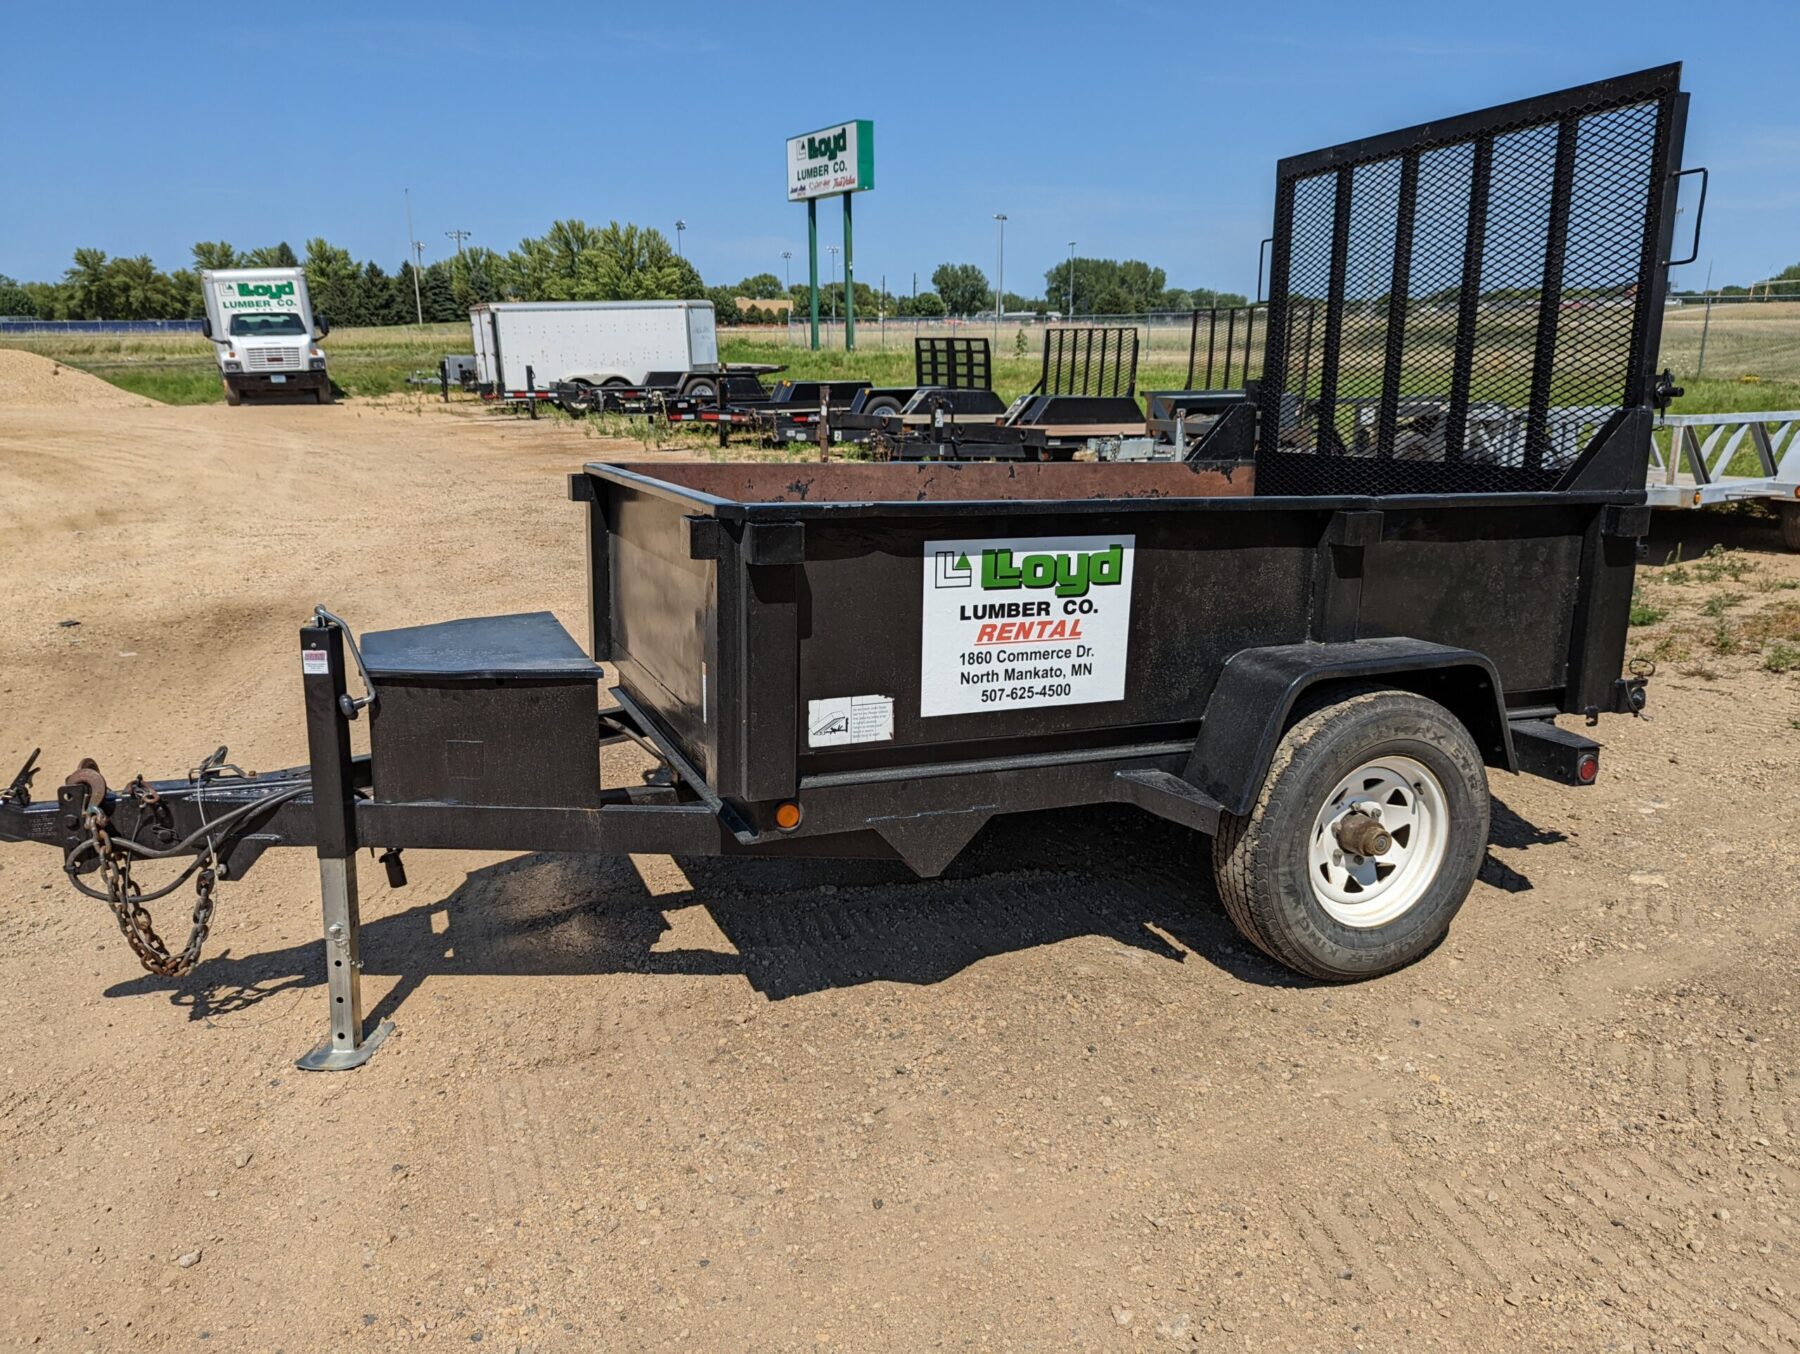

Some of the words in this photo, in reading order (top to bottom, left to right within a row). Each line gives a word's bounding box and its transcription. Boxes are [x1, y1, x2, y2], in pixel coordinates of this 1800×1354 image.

[797, 164, 829, 181] LUMBER
[833, 160, 848, 174] CO.
[223, 299, 272, 309] LUMBER
[277, 299, 297, 307] CO.
[960, 601, 1051, 620] LUMBER
[1063, 599, 1099, 616] CO.
[976, 619, 1083, 643] RENTAL
[959, 651, 992, 666] 1860
[997, 648, 1072, 663] Commerce
[1076, 645, 1095, 658] Dr.
[960, 669, 999, 685] North
[1004, 666, 1066, 682] Mankato,
[1071, 663, 1093, 676] MN
[981, 683, 1072, 703] 507-625-4500
